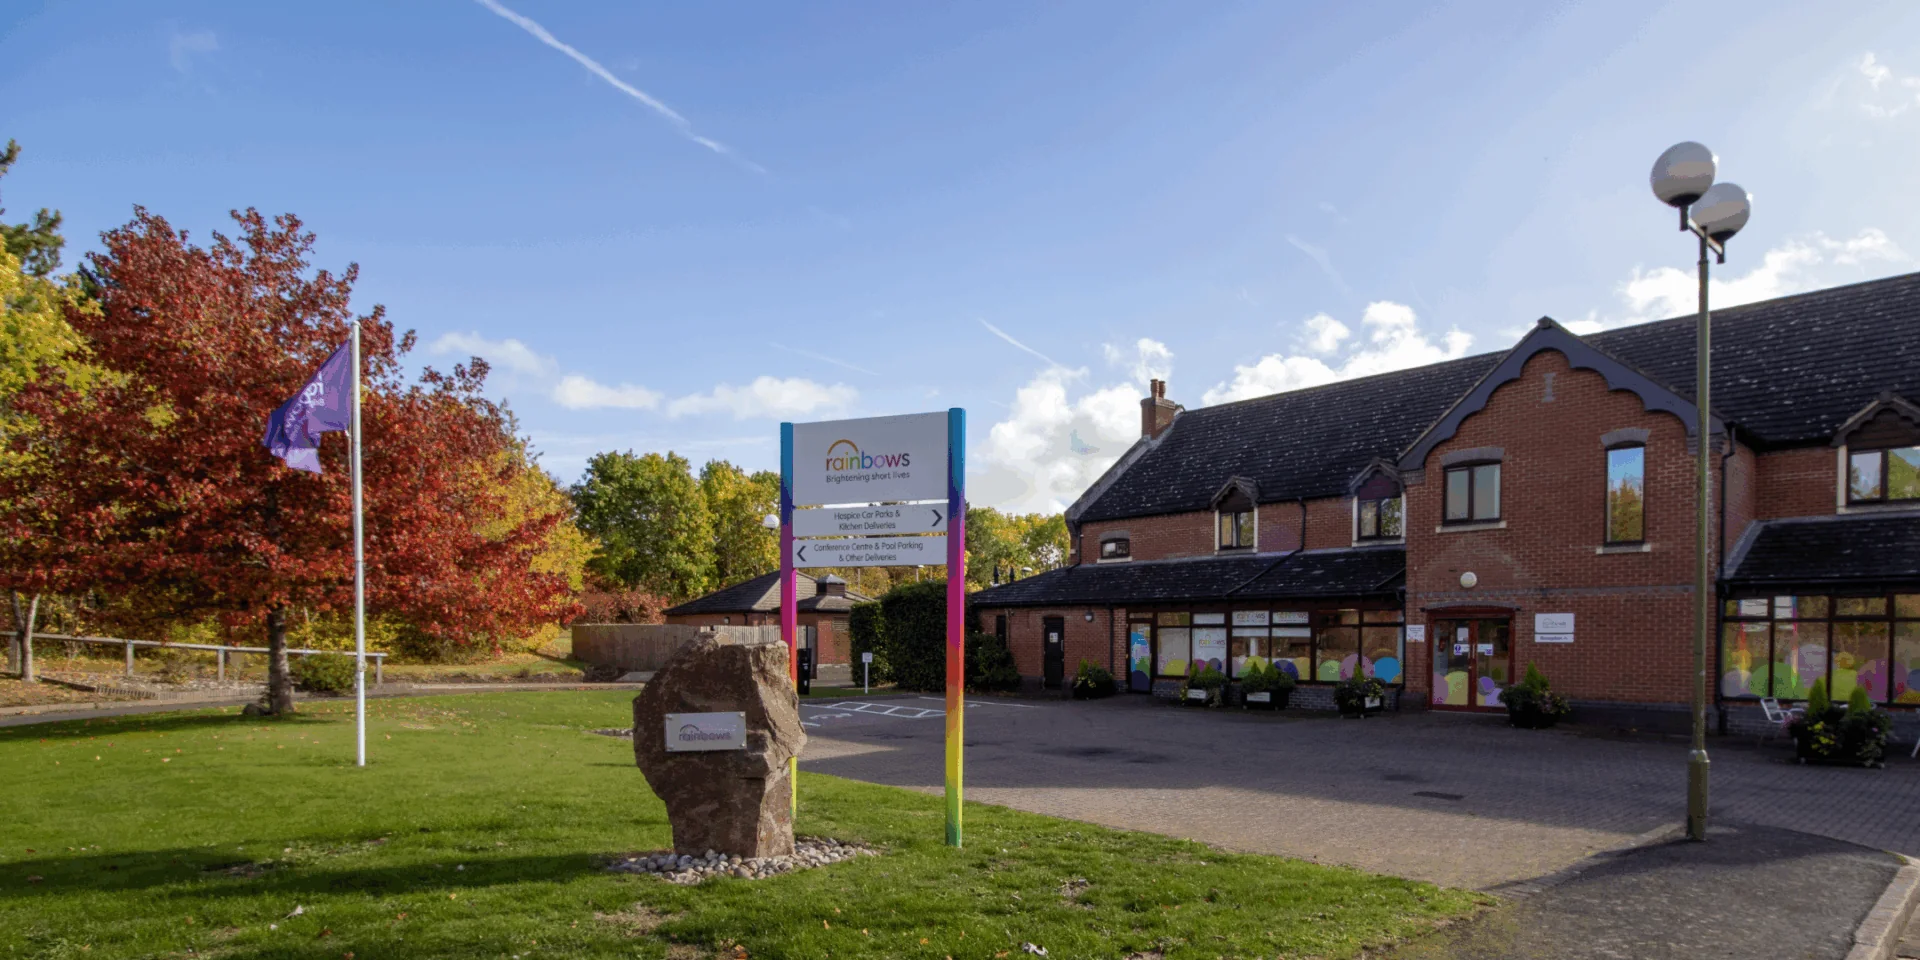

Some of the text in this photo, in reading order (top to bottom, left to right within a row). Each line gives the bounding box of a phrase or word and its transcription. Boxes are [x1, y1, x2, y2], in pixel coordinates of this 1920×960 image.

[826, 450, 911, 471] rainbows
[826, 471, 910, 484] Brightening short lives
[834, 509, 901, 521] Hospice Car Parks &
[839, 522, 896, 531] Kitchen Deliveries
[814, 543, 850, 552] Conference
[852, 543, 873, 551] Centre
[881, 542, 897, 550] Pool
[898, 541, 924, 551] Parking
[839, 553, 897, 562] & Other Deliveries
[679, 731, 732, 742] rainbows
